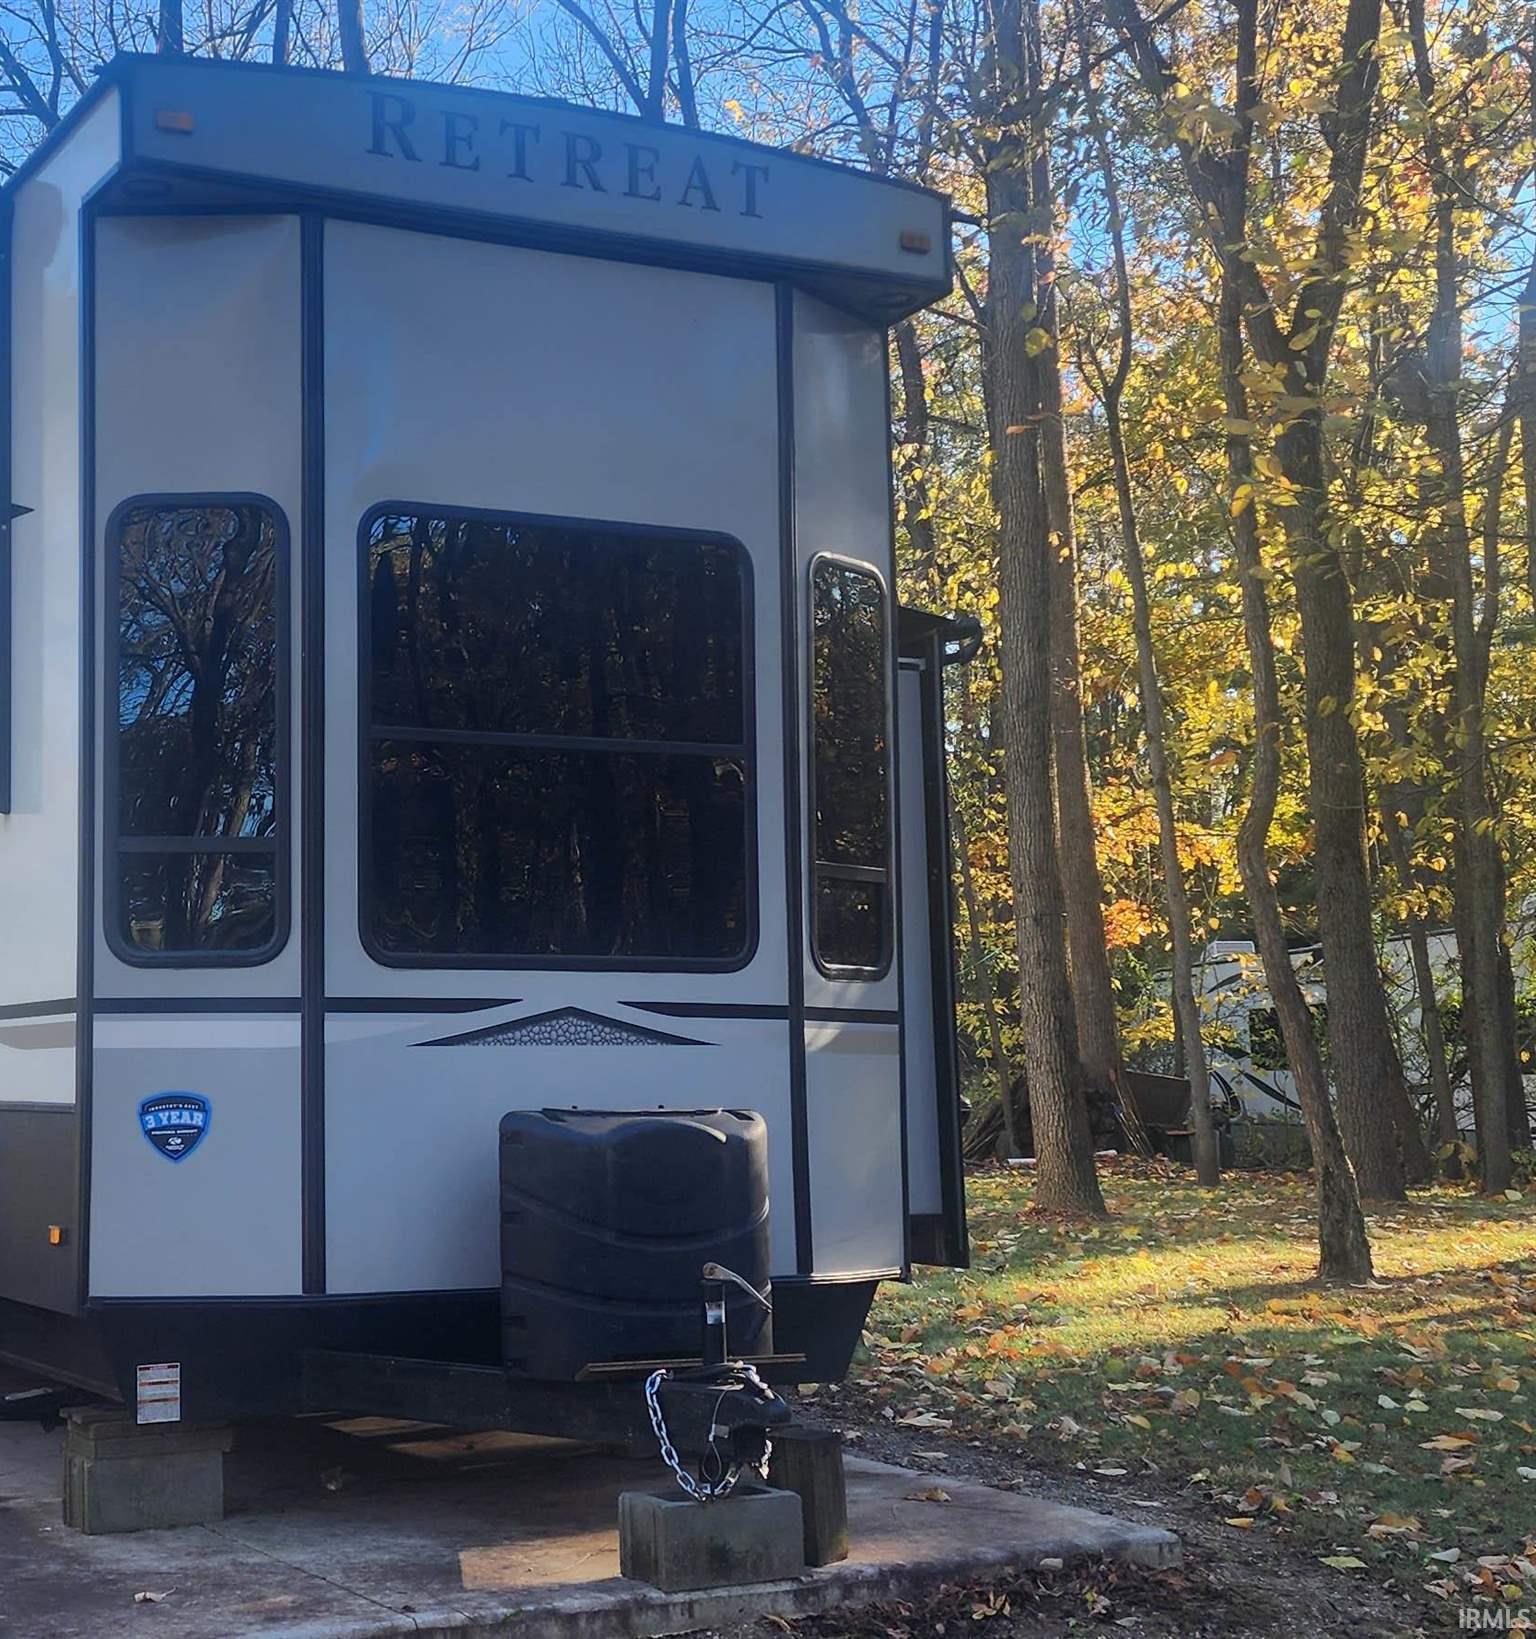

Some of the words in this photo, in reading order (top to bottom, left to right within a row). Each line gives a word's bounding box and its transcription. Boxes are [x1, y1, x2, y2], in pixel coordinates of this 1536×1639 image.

[366, 91, 769, 219] RETREAT
[145, 1115, 155, 1129] 3
[158, 1110, 203, 1126] YEAR
